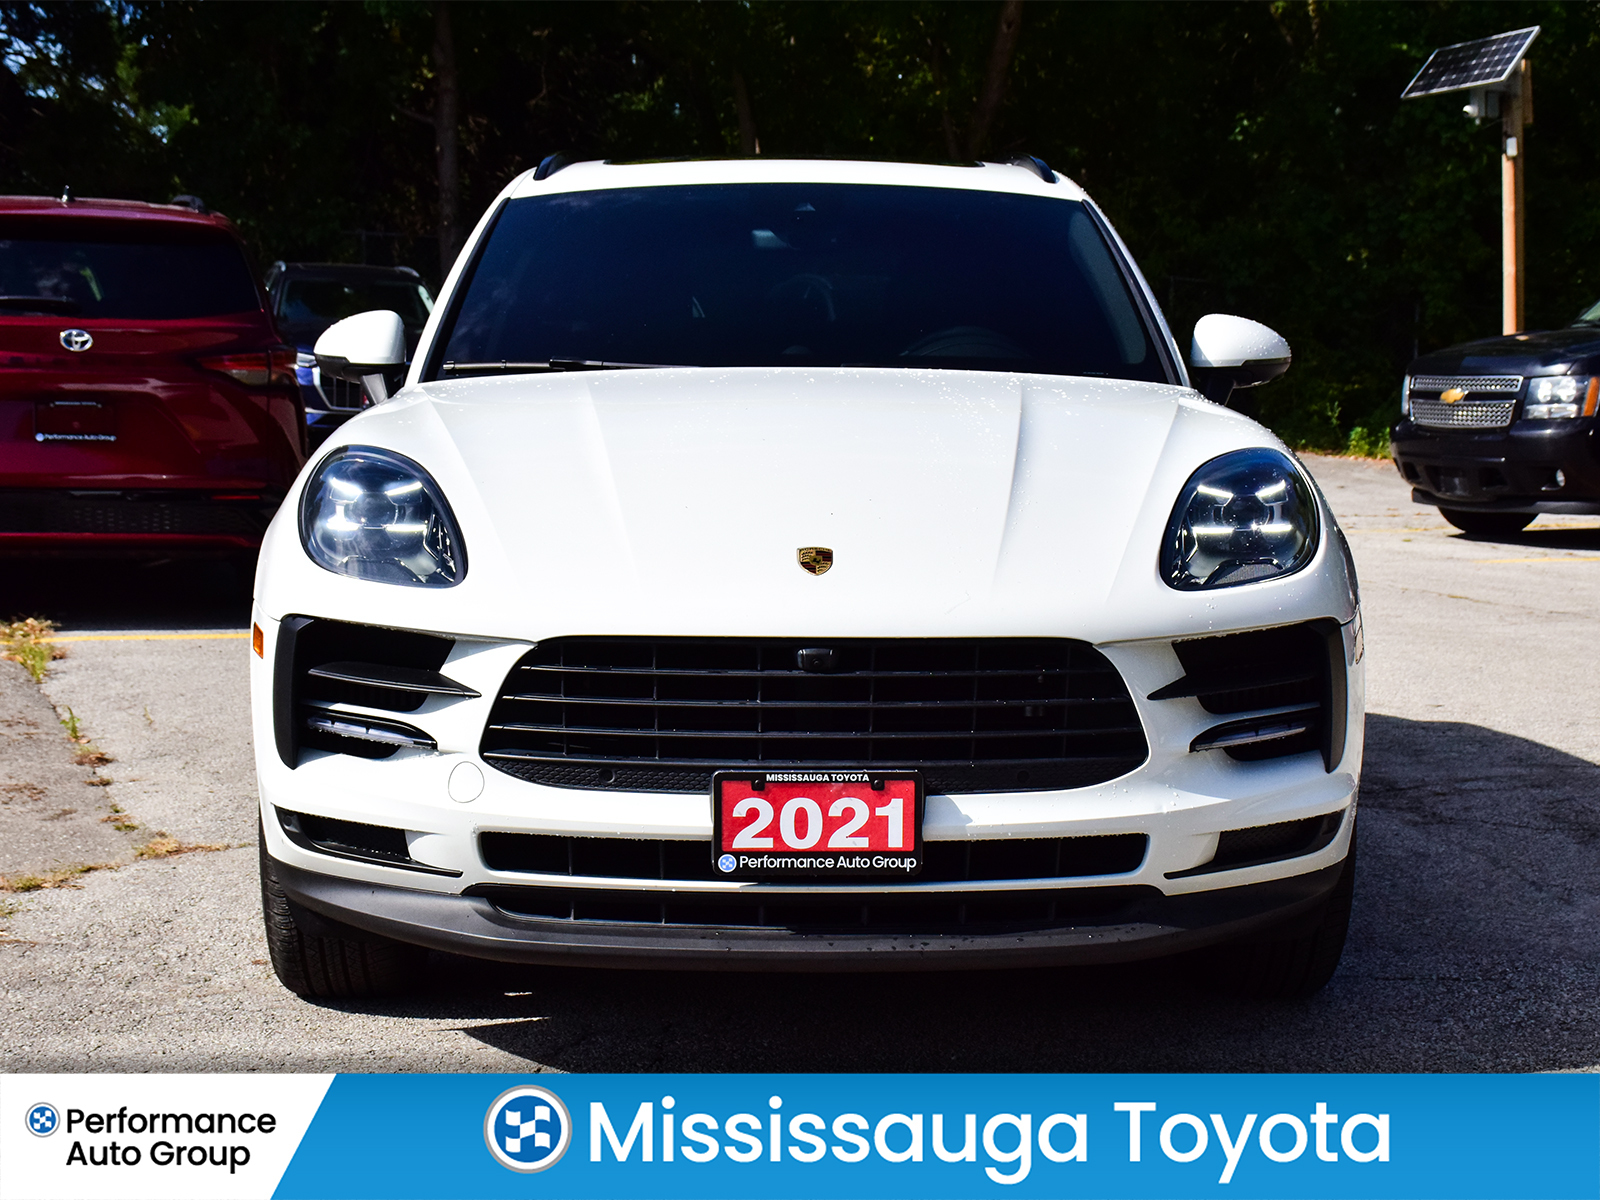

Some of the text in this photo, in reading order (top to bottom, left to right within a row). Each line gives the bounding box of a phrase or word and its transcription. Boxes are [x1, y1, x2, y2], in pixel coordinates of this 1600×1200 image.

[766, 773, 870, 782] MISSISSAUGA TOYOTA
[732, 797, 904, 849] 2021
[739, 854, 917, 872] Performance Auto Group
